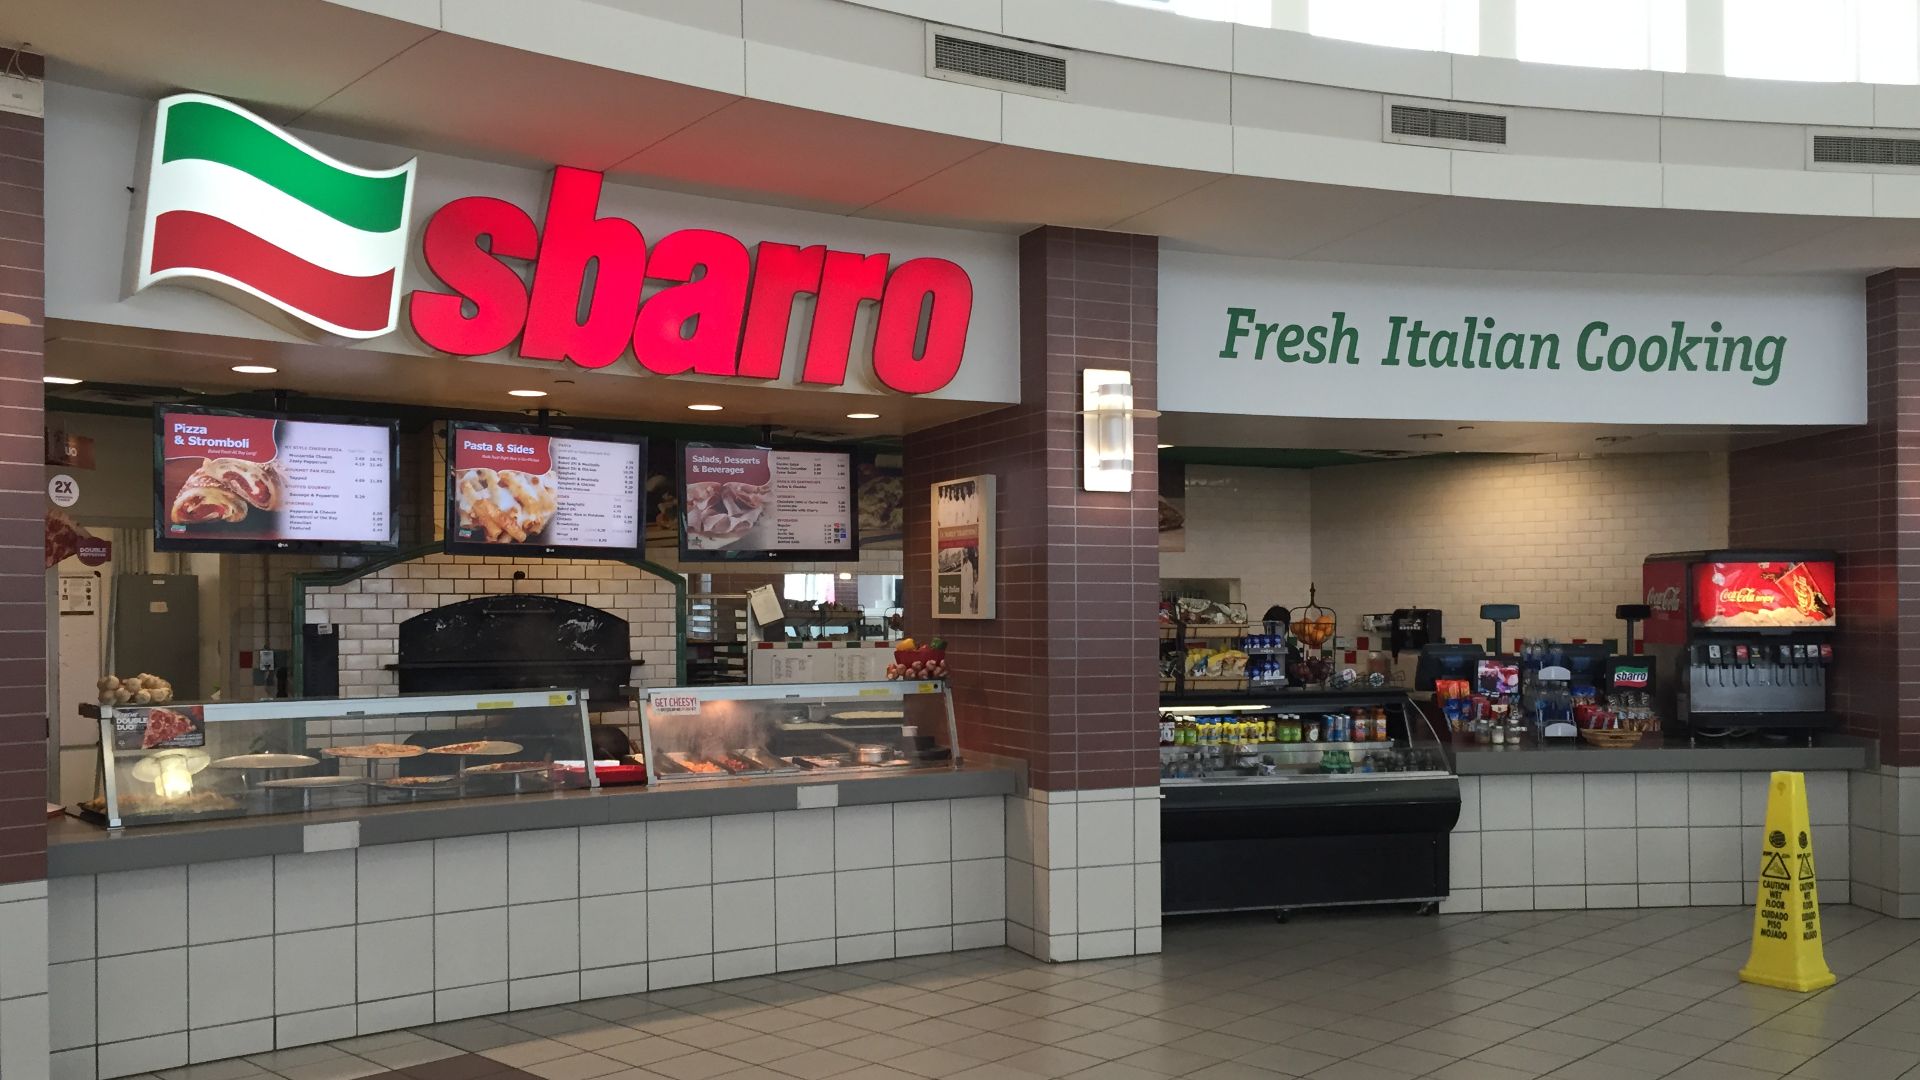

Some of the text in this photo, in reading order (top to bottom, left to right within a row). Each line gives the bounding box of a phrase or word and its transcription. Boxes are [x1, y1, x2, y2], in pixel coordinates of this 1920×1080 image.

[409, 164, 973, 395] sbarro
[1219, 307, 1788, 386] Fresh Italian Cooking
[174, 423, 208, 435] Pizza
[174, 435, 250, 449] & Stromboli
[463, 440, 535, 455] Pasta & Sides
[64, 446, 78, 457] UO
[692, 455, 760, 465] Salads, Desserts
[692, 465, 745, 475] & Beverages
[54, 480, 73, 494] 2X
[1646, 585, 1681, 612] Coca-Cola
[1720, 587, 1756, 603] Coca-Cola
[1615, 670, 1647, 681] sbarro
[655, 696, 697, 707] GET CHEESY!
[1763, 880, 1790, 891] CAUTION
[1769, 890, 1782, 900] WET
[1765, 899, 1785, 910] FLOOR
[1761, 909, 1789, 921] CUIDADO
[1767, 920, 1782, 930] PISO
[1760, 928, 1788, 940] MOJADO
